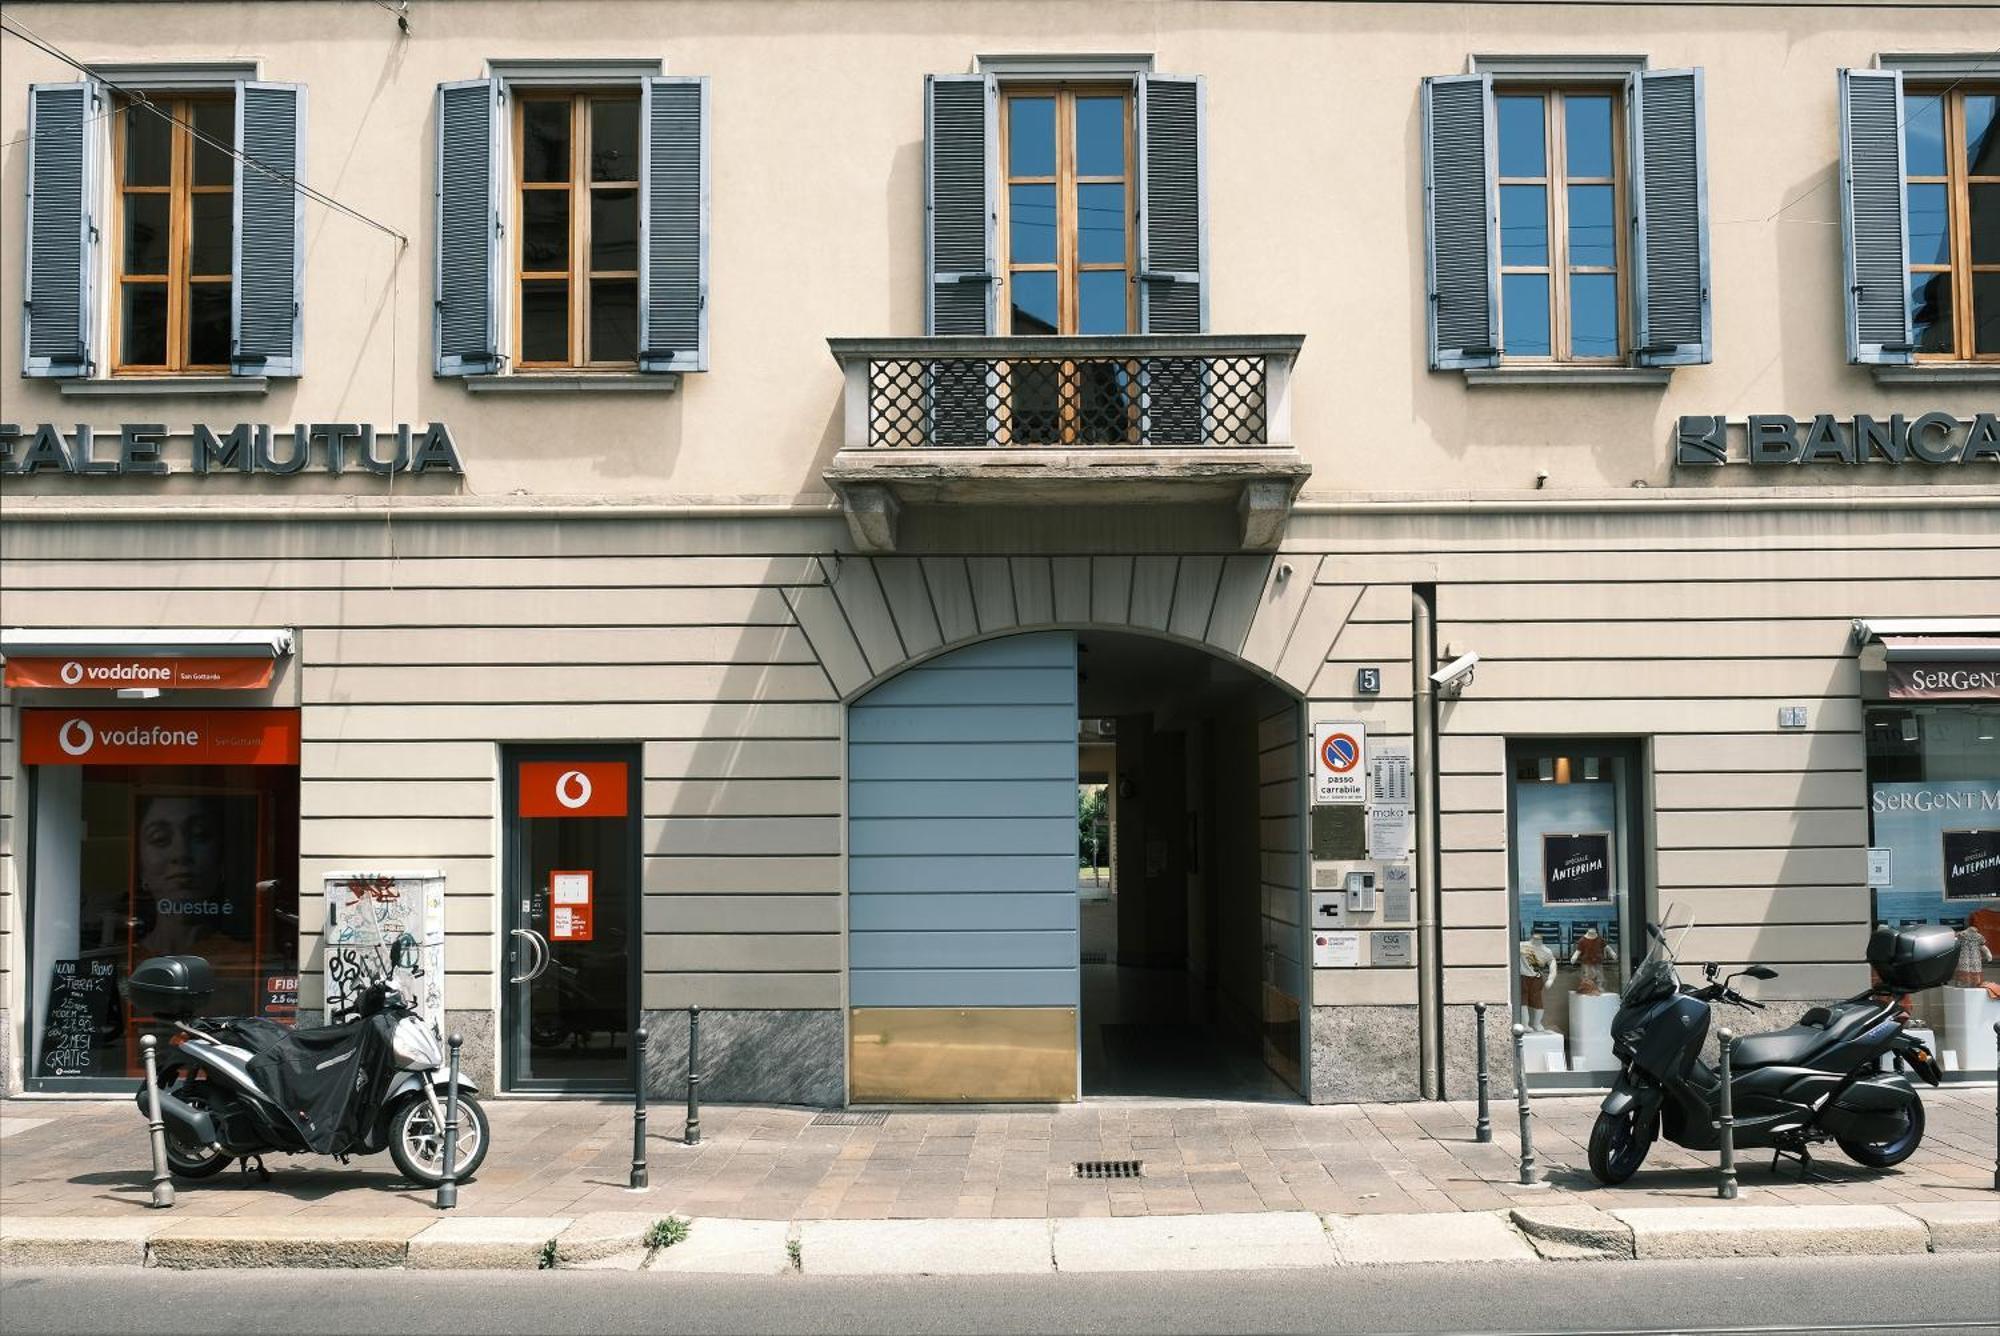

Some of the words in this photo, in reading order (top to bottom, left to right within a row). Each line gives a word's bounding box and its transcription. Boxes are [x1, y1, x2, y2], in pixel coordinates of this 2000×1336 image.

[191, 422, 464, 474] MUTUA
[1748, 412, 2000, 465] BANCA
[87, 664, 170, 680] vodafone
[1364, 670, 1375, 689] 5
[100, 726, 198, 746] vodafone
[1321, 786, 1360, 794] carrabile
[1552, 859, 1602, 882] ANTEPRIMA
[157, 899, 218, 914] Questa
[45, 1049, 90, 1068] GRATIS
